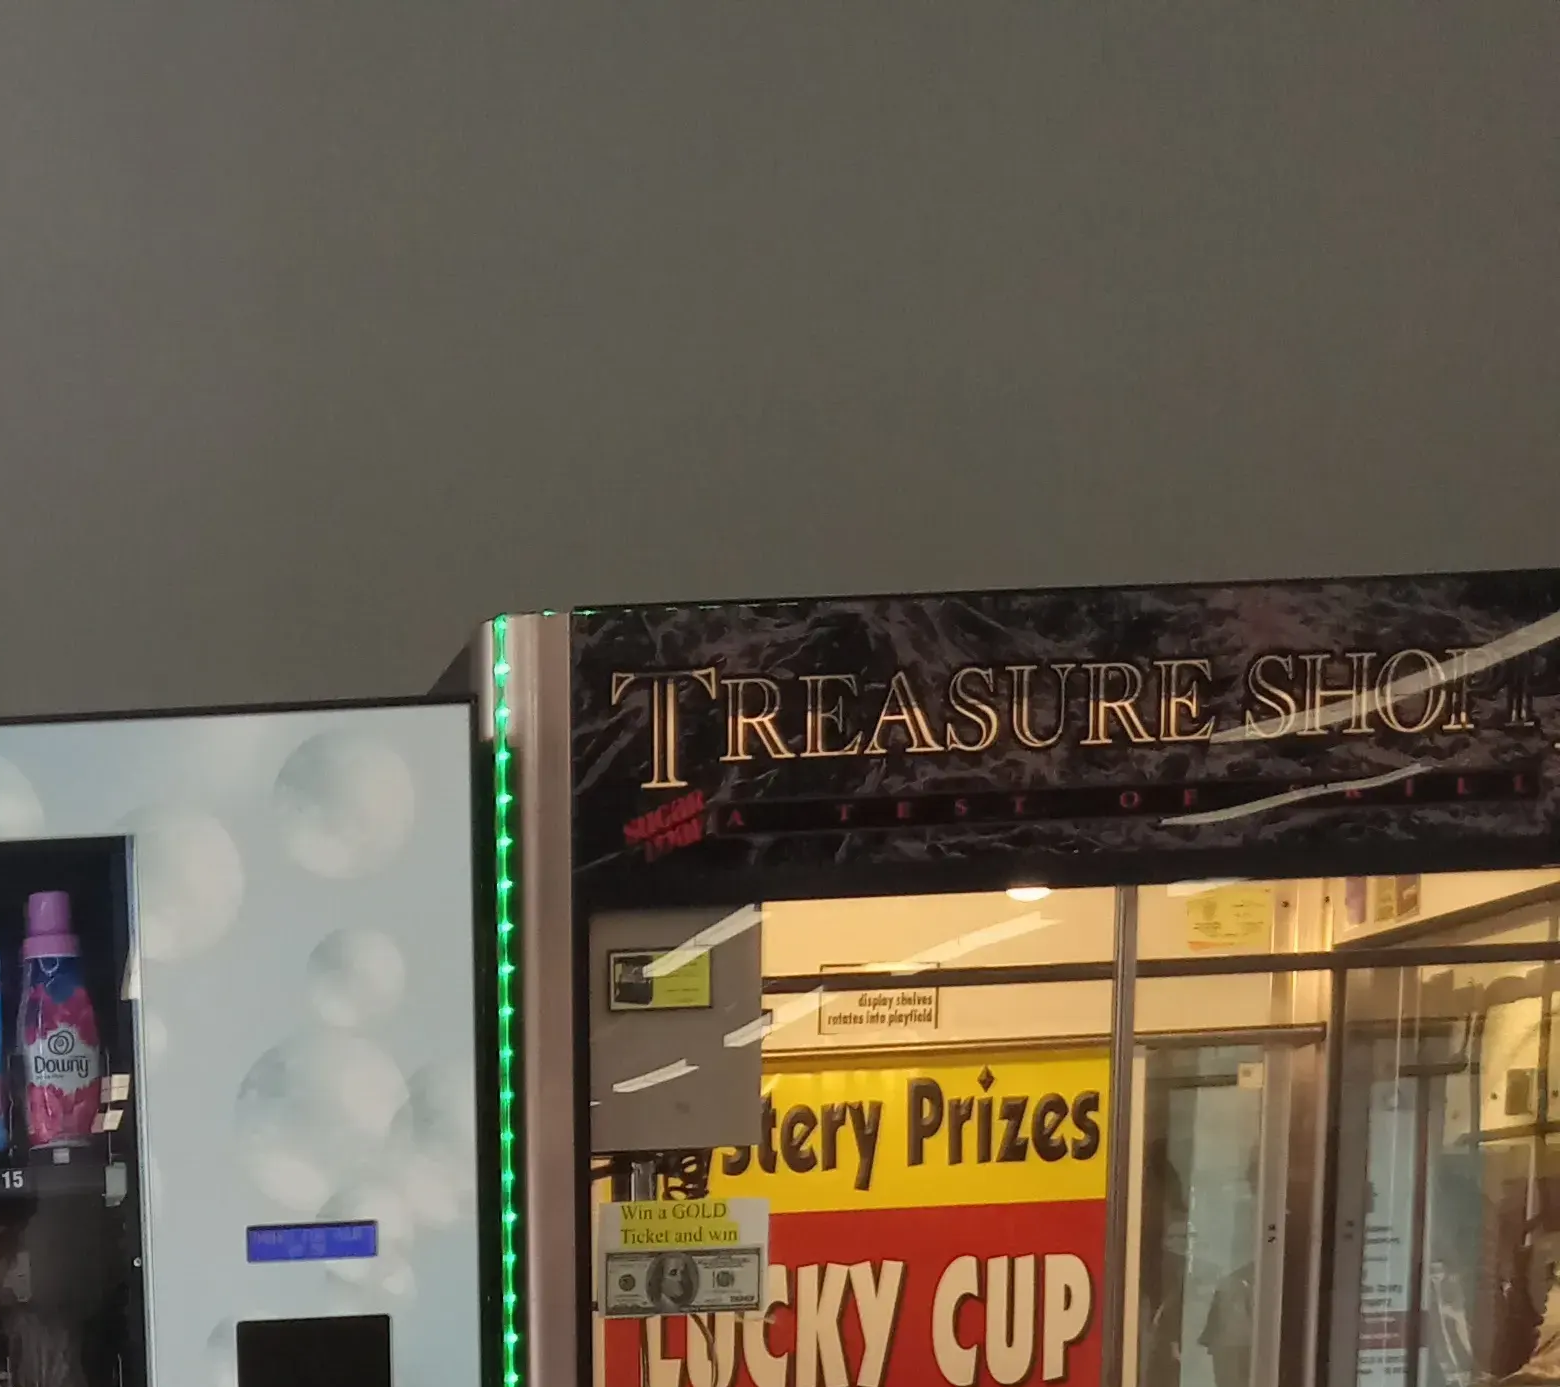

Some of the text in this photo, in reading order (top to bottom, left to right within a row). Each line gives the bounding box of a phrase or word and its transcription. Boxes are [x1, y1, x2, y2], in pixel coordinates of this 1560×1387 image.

[611, 667, 1216, 790] TREASURE
[858, 991, 933, 1010] display shelves
[33, 1055, 89, 1079] Downy
[907, 1064, 1102, 1168] Prizes
[1, 1171, 24, 1189] 15
[621, 1202, 727, 1221] Win a GOLD
[620, 1226, 738, 1245] Ticket and win
[931, 1253, 1092, 1387] CUP
